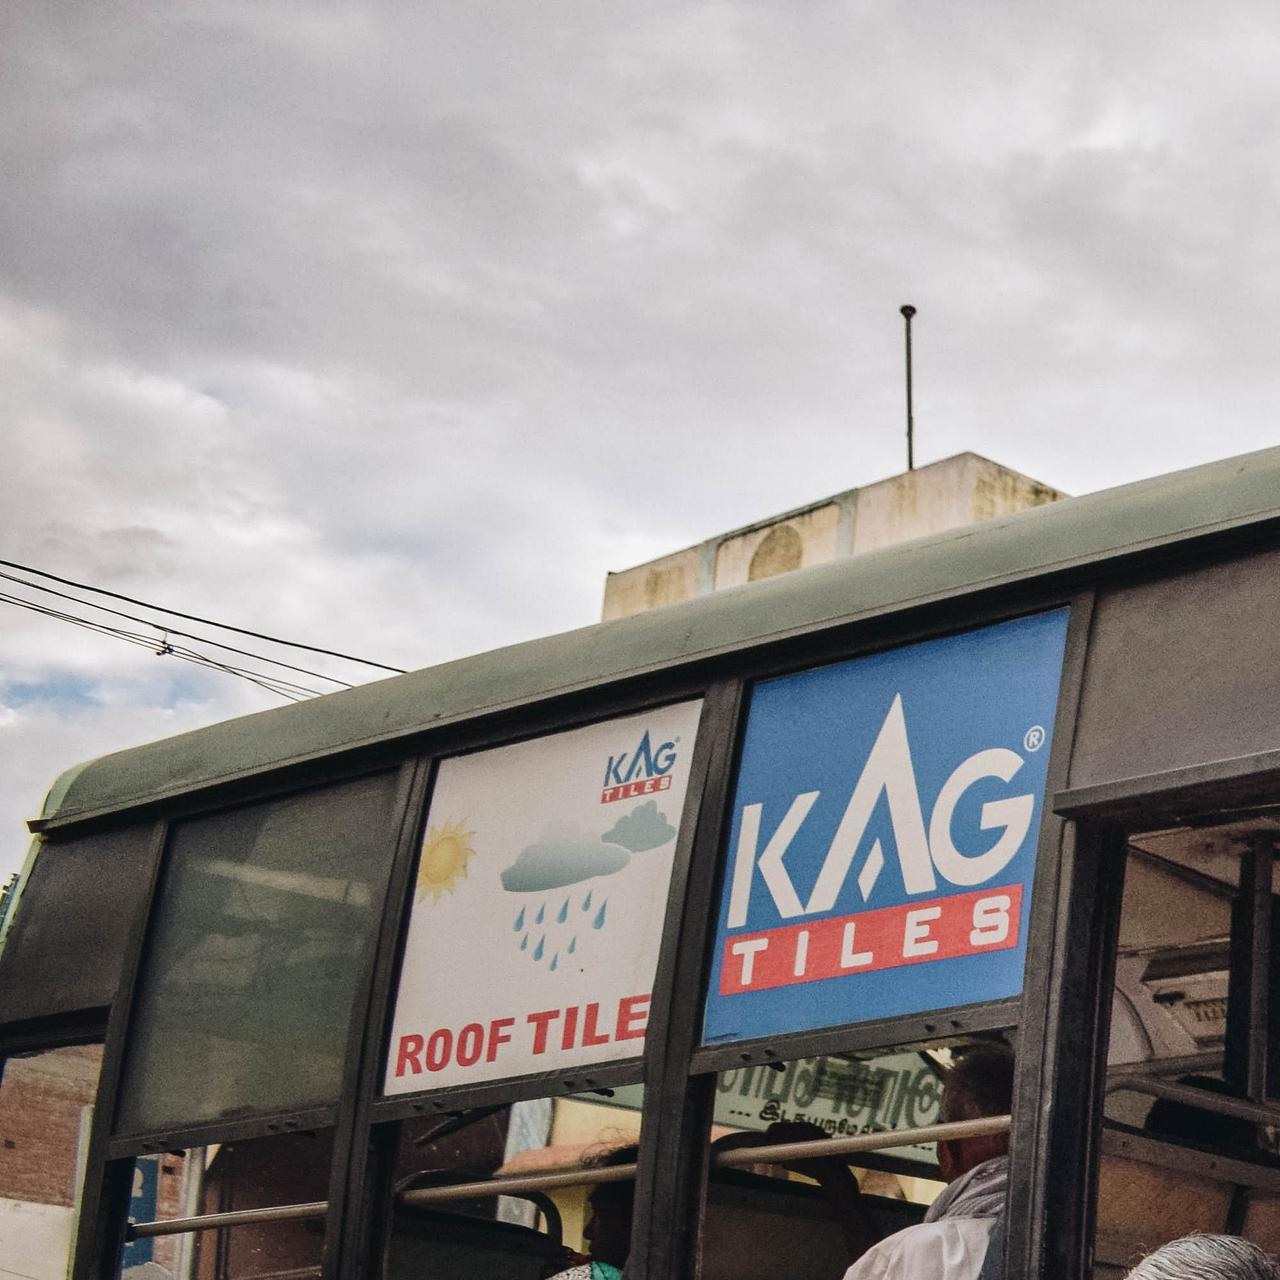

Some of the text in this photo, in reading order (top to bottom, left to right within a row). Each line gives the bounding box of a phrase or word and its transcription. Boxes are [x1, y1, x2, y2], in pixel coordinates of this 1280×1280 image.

[603, 728, 678, 788] KAG
[602, 776, 670, 803] TILES
[727, 692, 1035, 929] KAG
[730, 898, 1013, 987] TILES
[394, 1016, 516, 1078] ROOF
